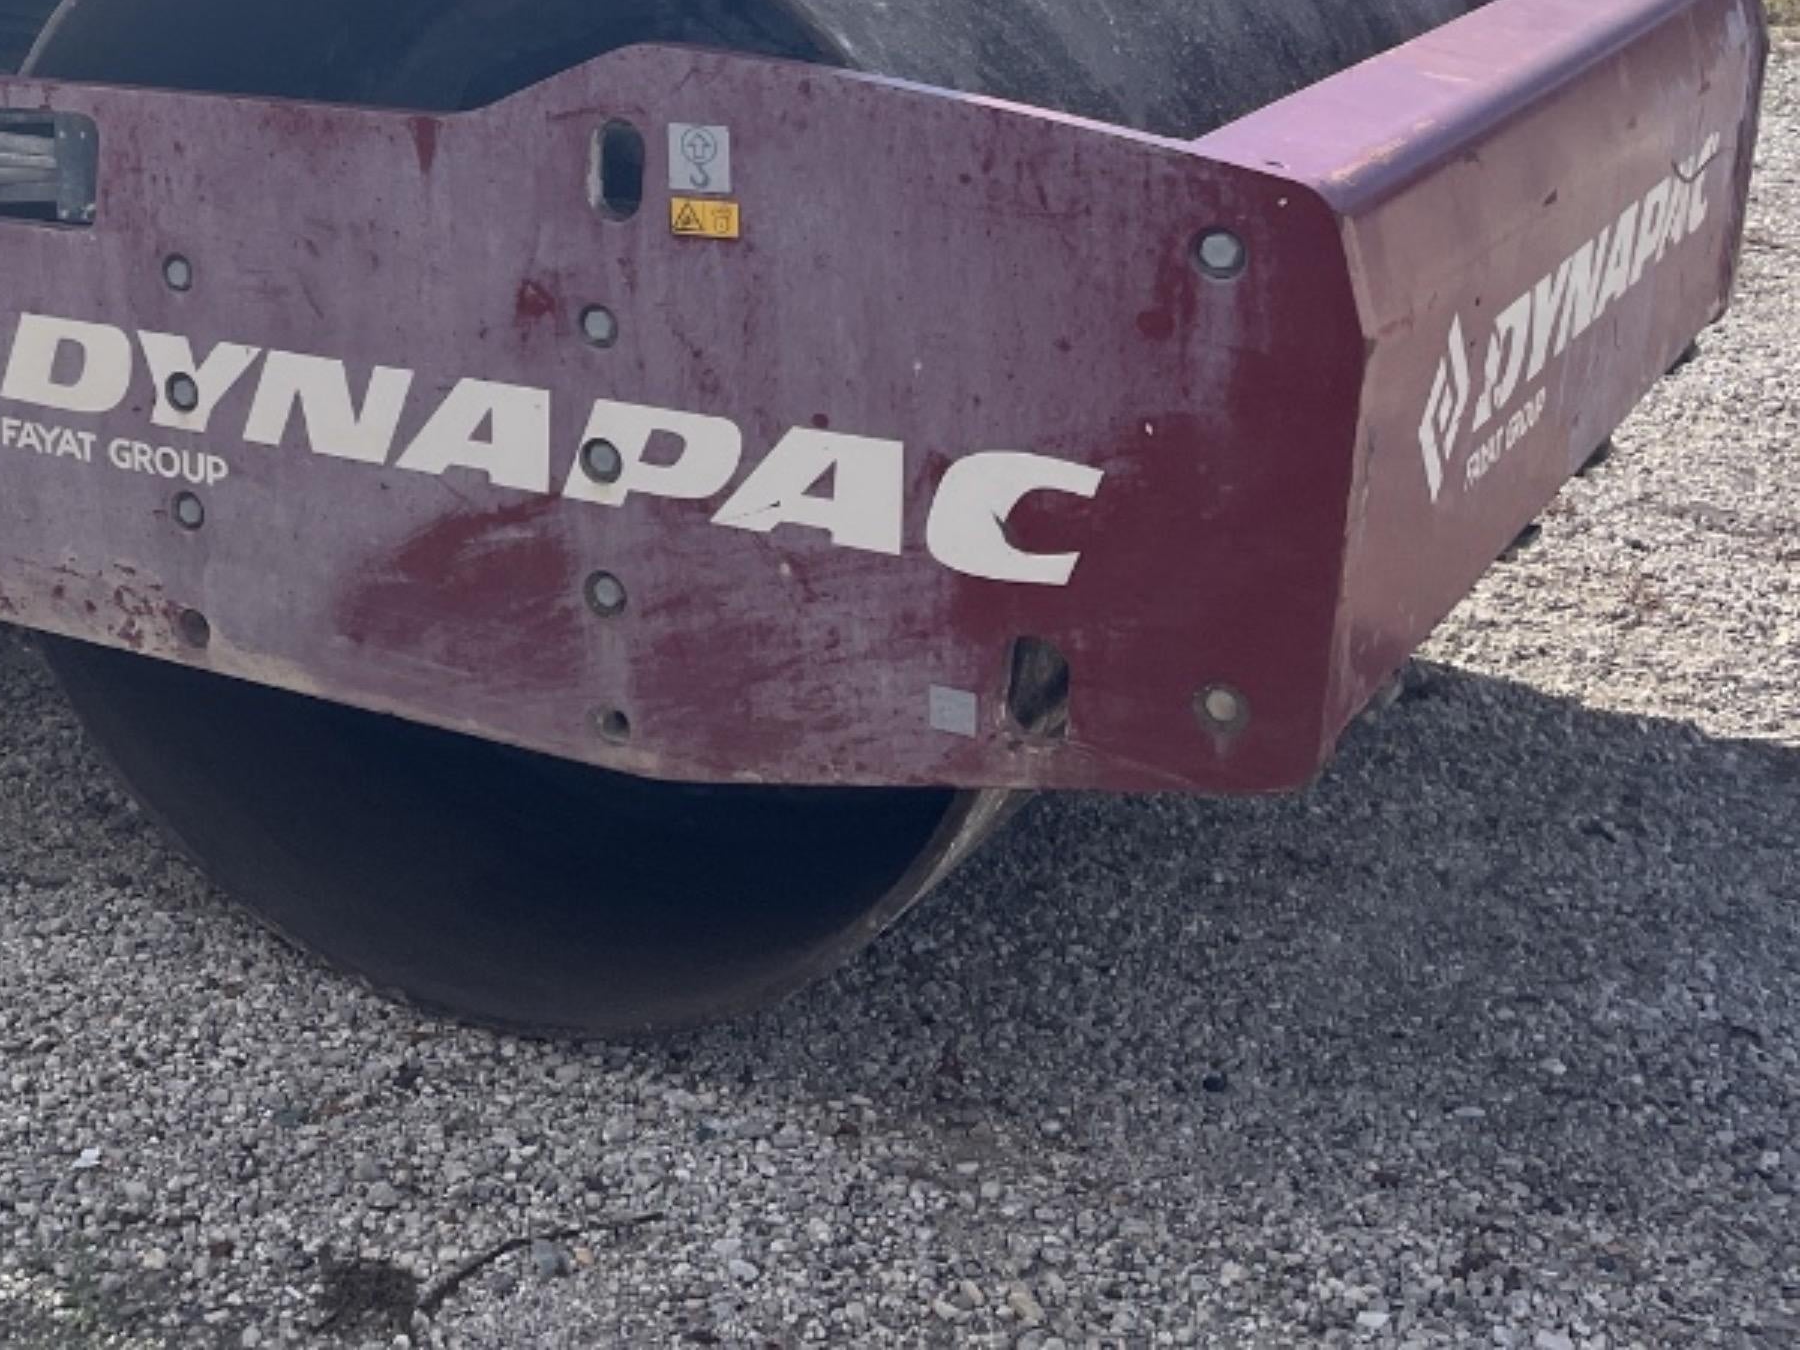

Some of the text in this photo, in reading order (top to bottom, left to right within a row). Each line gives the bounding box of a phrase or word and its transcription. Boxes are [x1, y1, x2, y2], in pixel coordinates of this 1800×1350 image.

[1472, 131, 1720, 432] DYNAPAC
[0, 311, 1104, 586] DYNAPAC
[2, 416, 229, 486] FAYAT GROUP
